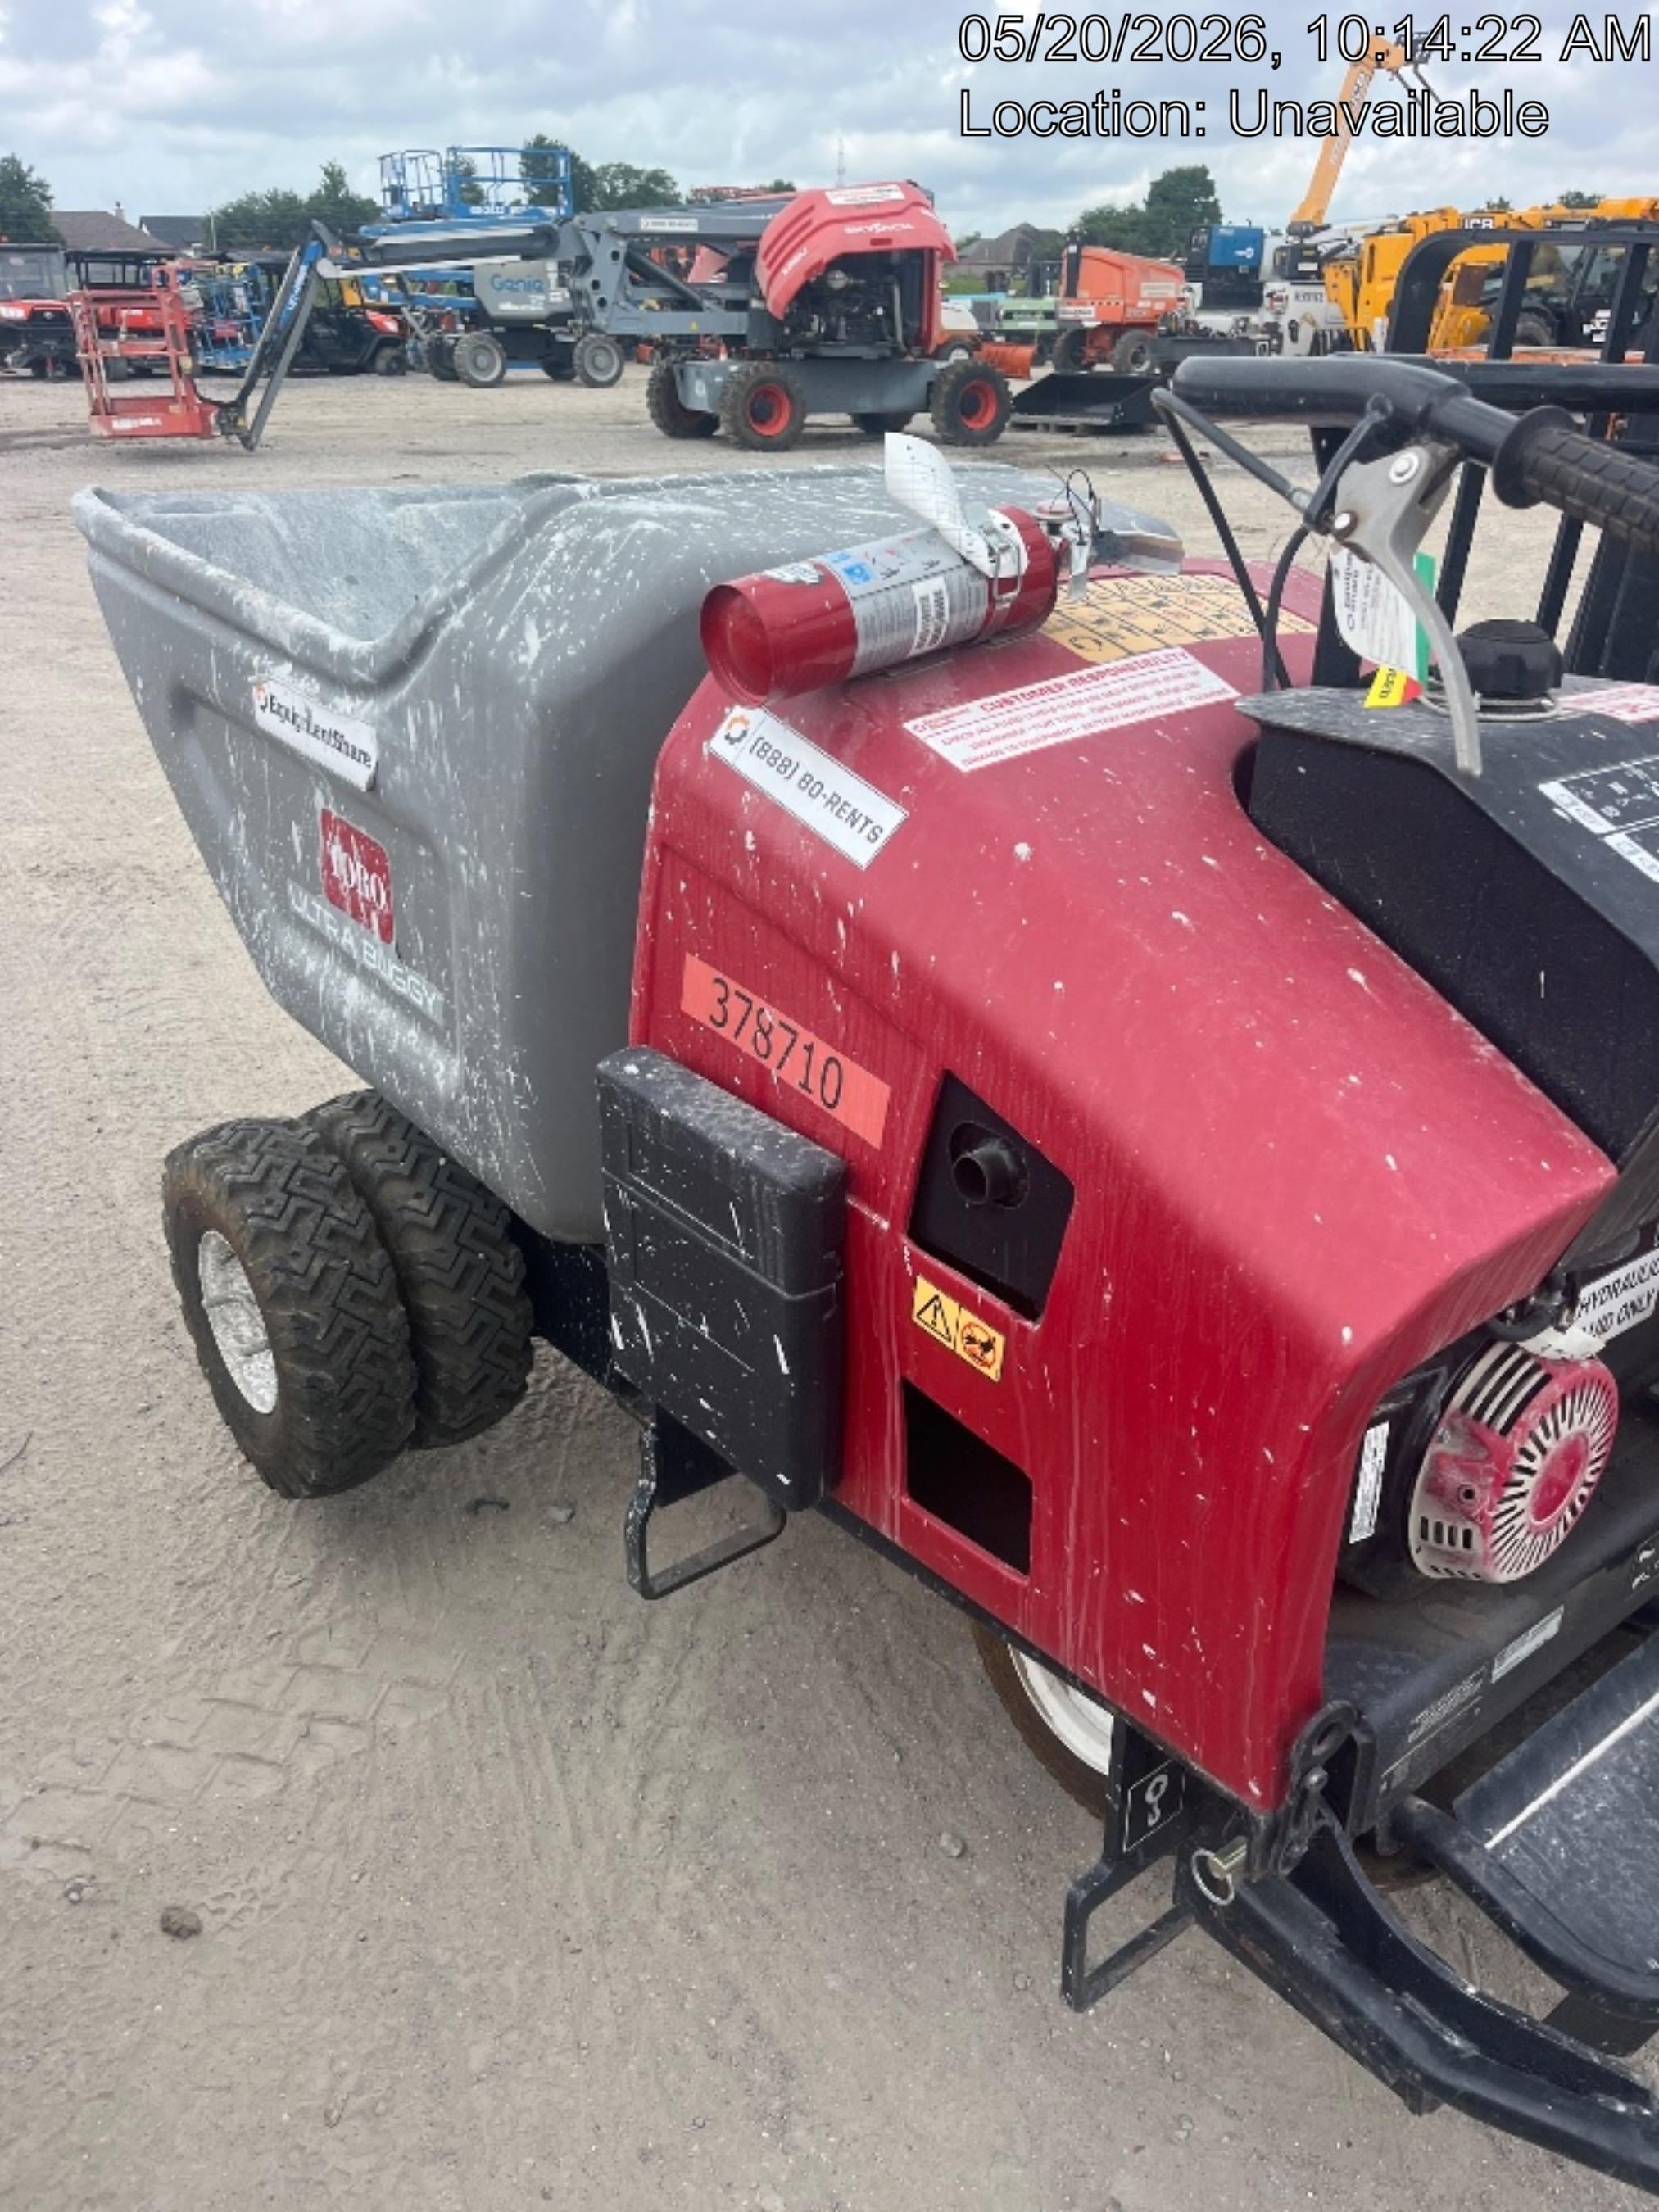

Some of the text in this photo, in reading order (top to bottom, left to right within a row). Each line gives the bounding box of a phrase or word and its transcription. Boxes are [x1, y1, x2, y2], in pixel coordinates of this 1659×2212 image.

[490, 273, 544, 292] Genie
[979, 681, 1066, 712] CUSTOMER
[1067, 650, 1189, 689] RESPONSIBILITY
[749, 736, 884, 844] (888) 80-RENTS
[288, 882, 444, 1015] ULTRA BUGGY
[709, 977, 843, 1110] 378710
[1616, 1286, 1656, 1326] ONLY
